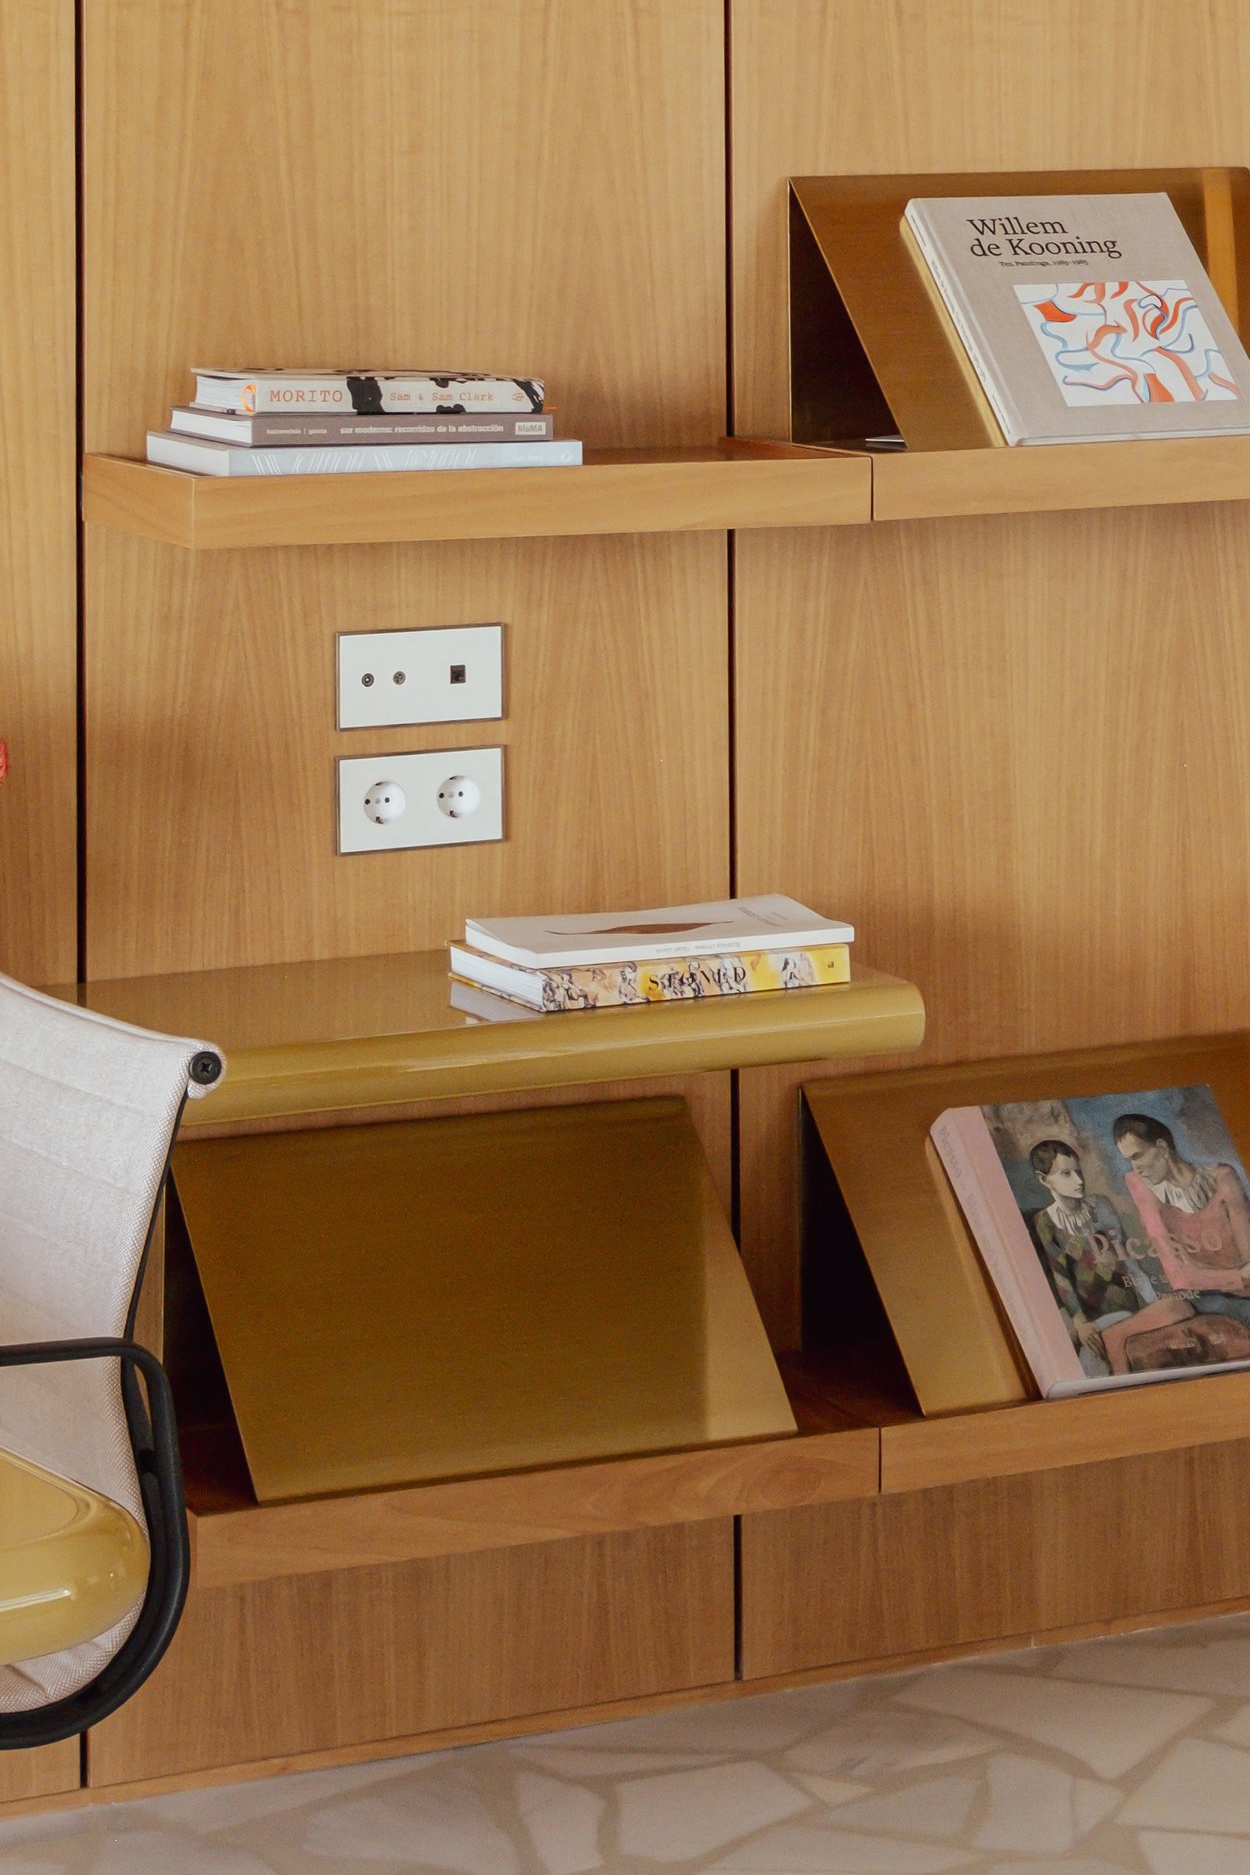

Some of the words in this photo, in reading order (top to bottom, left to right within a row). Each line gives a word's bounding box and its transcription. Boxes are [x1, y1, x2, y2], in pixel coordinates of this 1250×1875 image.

[966, 216, 1068, 236] Willem
[970, 237, 1002, 257] de
[1005, 236, 1123, 259] Kooning
[269, 389, 343, 403] MORITO
[389, 392, 411, 401] Sam
[431, 392, 453, 401] Sam
[459, 391, 495, 401] Clark
[436, 425, 448, 433] de
[448, 424, 457, 433] la
[517, 424, 543, 433] MoMA
